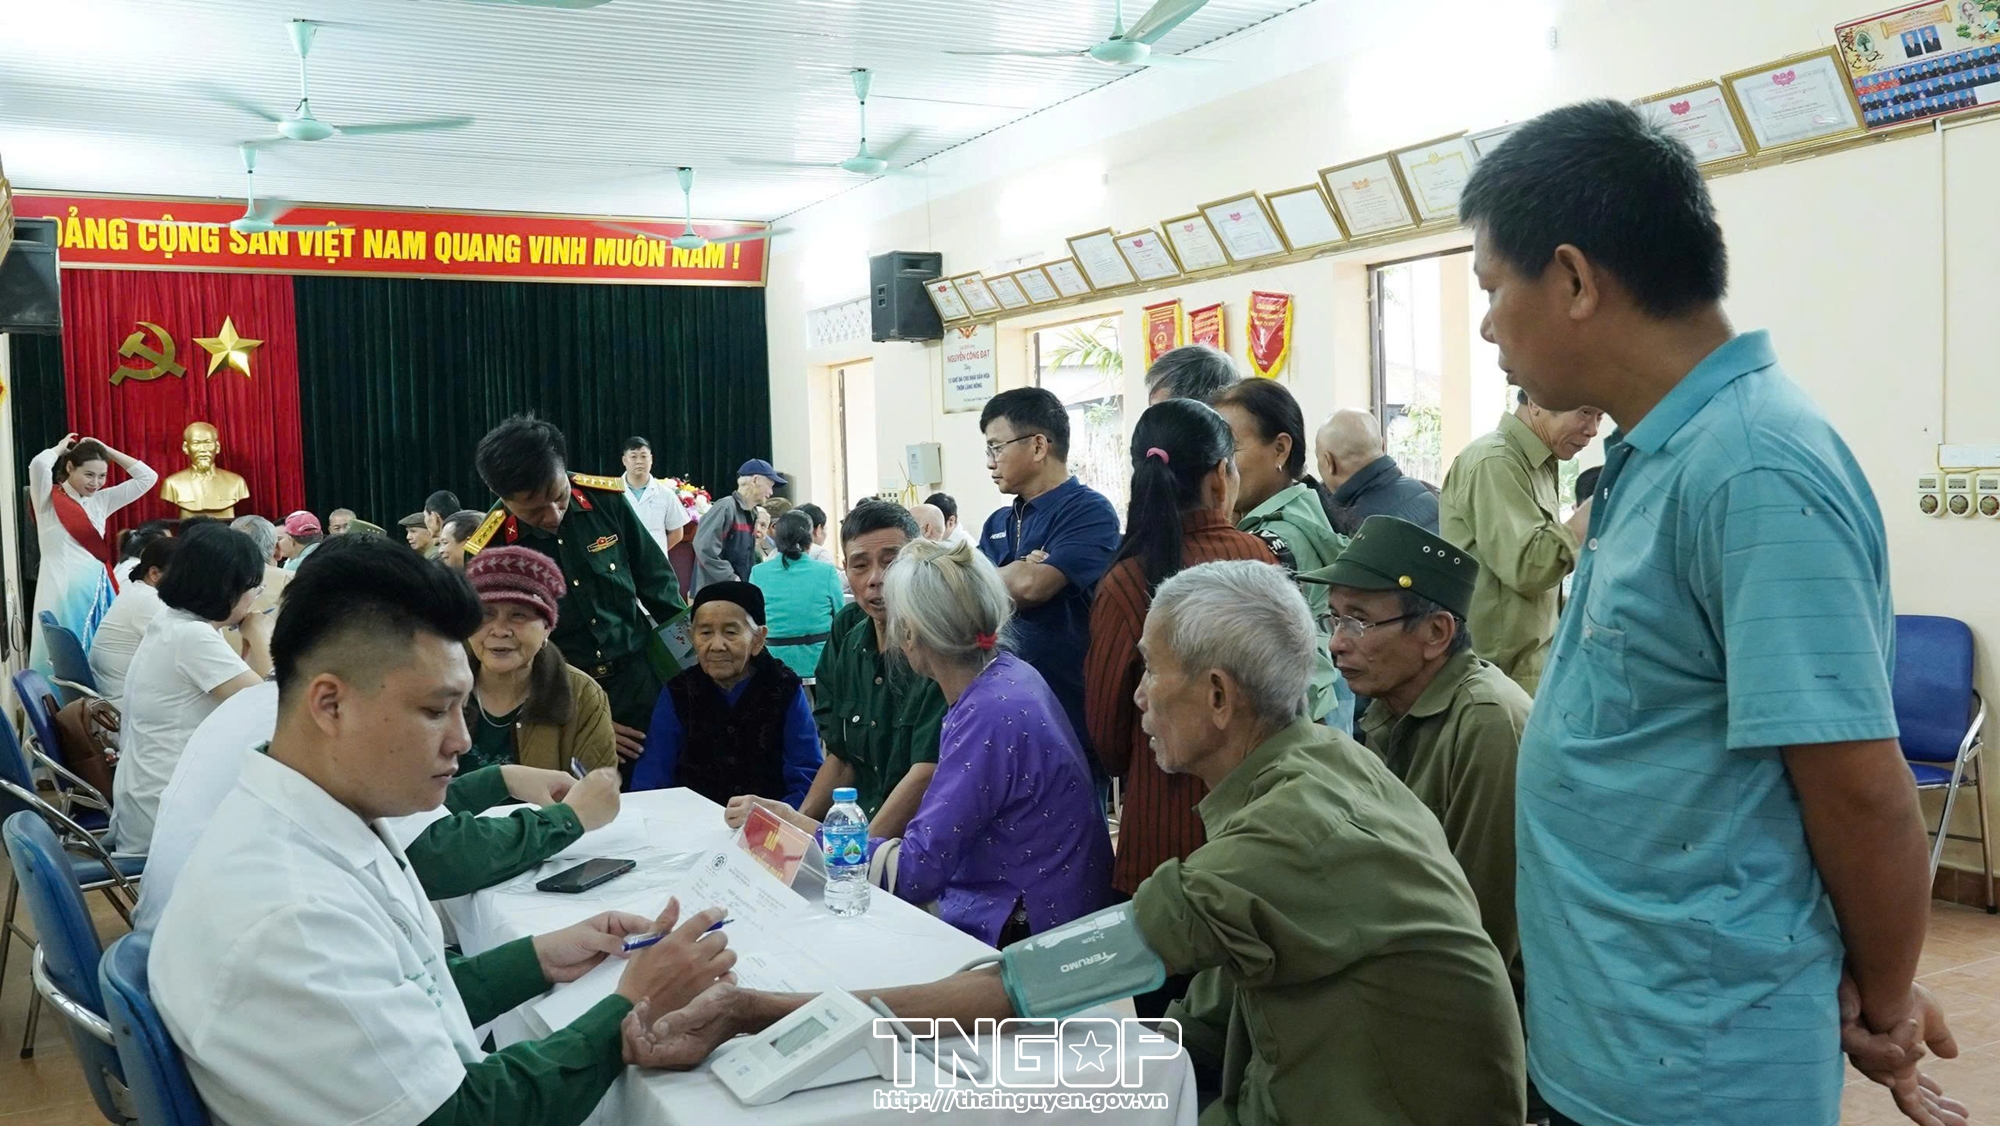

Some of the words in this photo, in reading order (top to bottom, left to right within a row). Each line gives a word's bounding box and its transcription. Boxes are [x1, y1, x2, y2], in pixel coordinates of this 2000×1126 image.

[138, 214, 220, 258] CỘNG
[297, 220, 356, 264] VIỆT
[363, 229, 426, 260] NAM
[434, 231, 521, 264] QUANG
[528, 235, 587, 265] VINH
[593, 234, 666, 267] MUÔN
[732, 242, 741, 270] !
[1060, 951, 1118, 973] TERUMO
